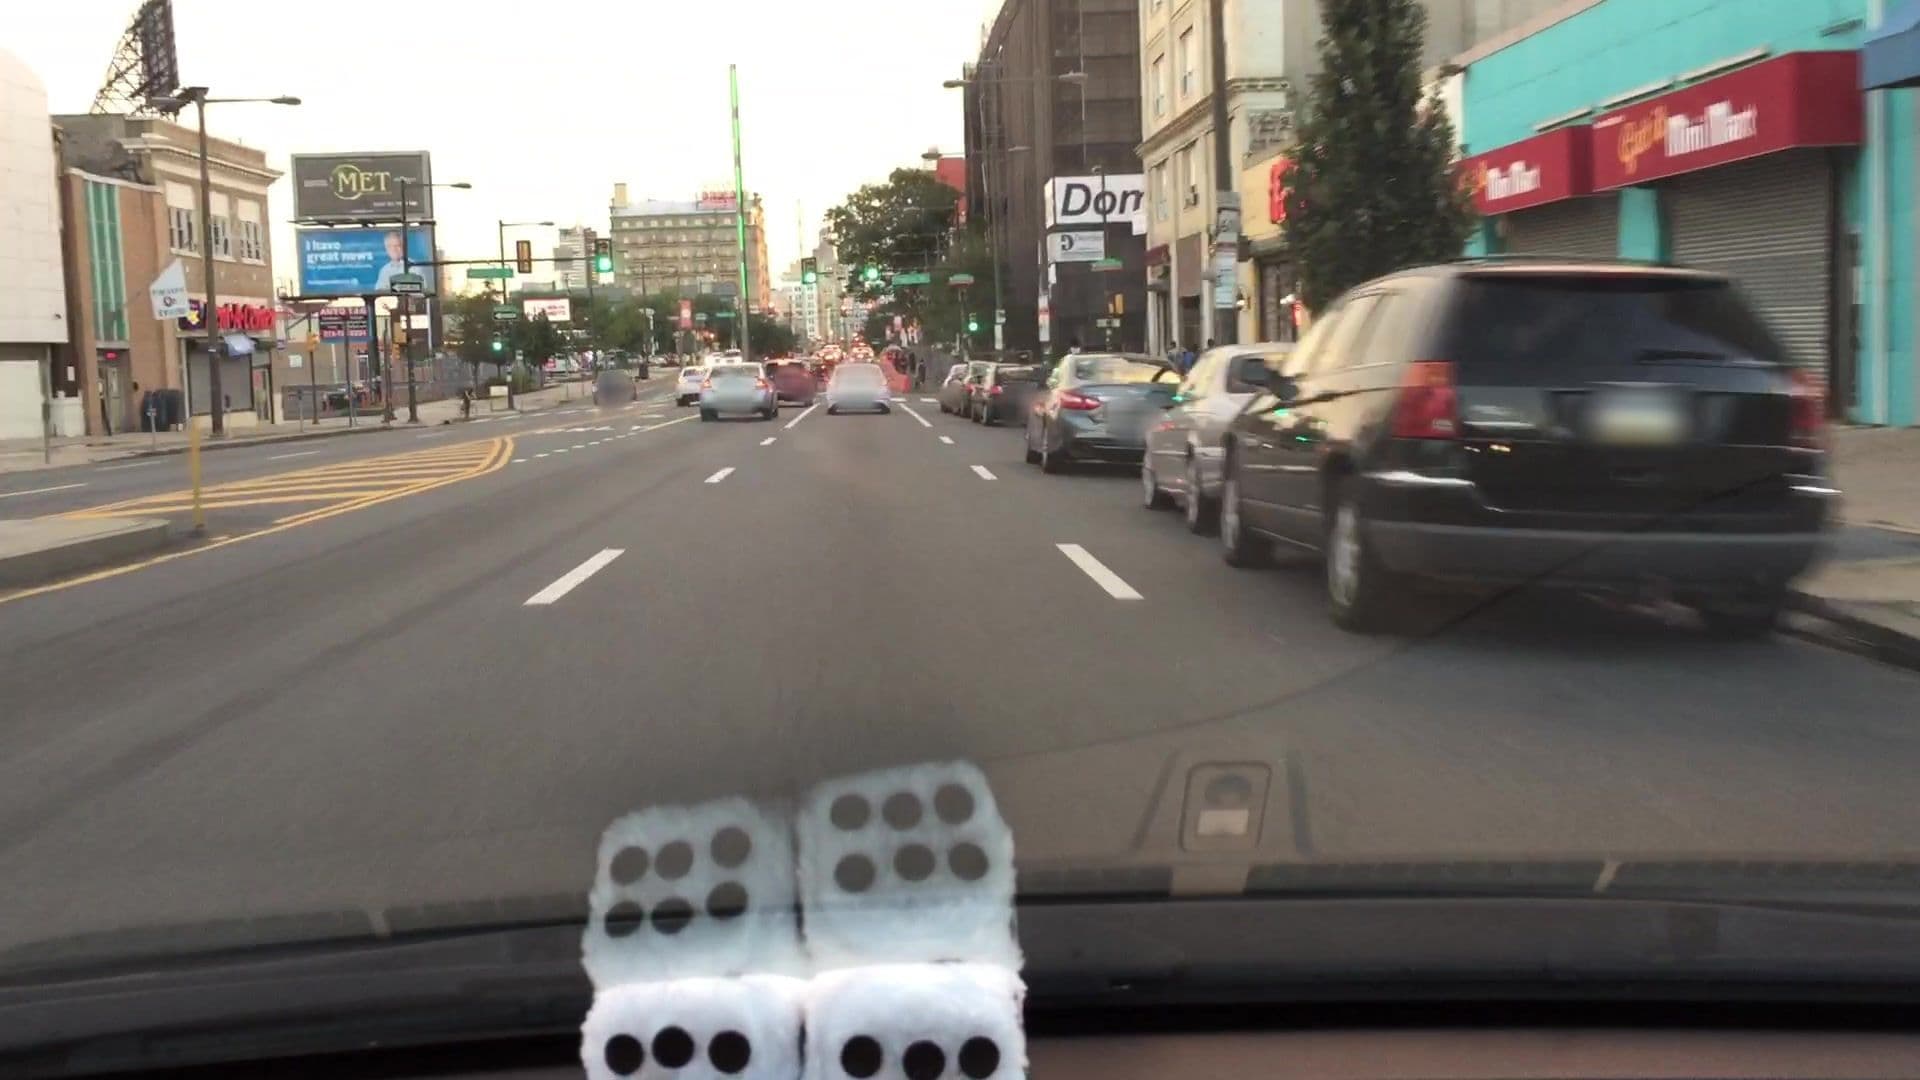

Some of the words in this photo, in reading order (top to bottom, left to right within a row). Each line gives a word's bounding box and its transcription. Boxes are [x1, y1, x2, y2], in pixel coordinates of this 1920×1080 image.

[338, 171, 391, 193] MET
[305, 239, 311, 251] I
[312, 239, 342, 251] have
[306, 251, 340, 264] great
[341, 251, 374, 262] news
